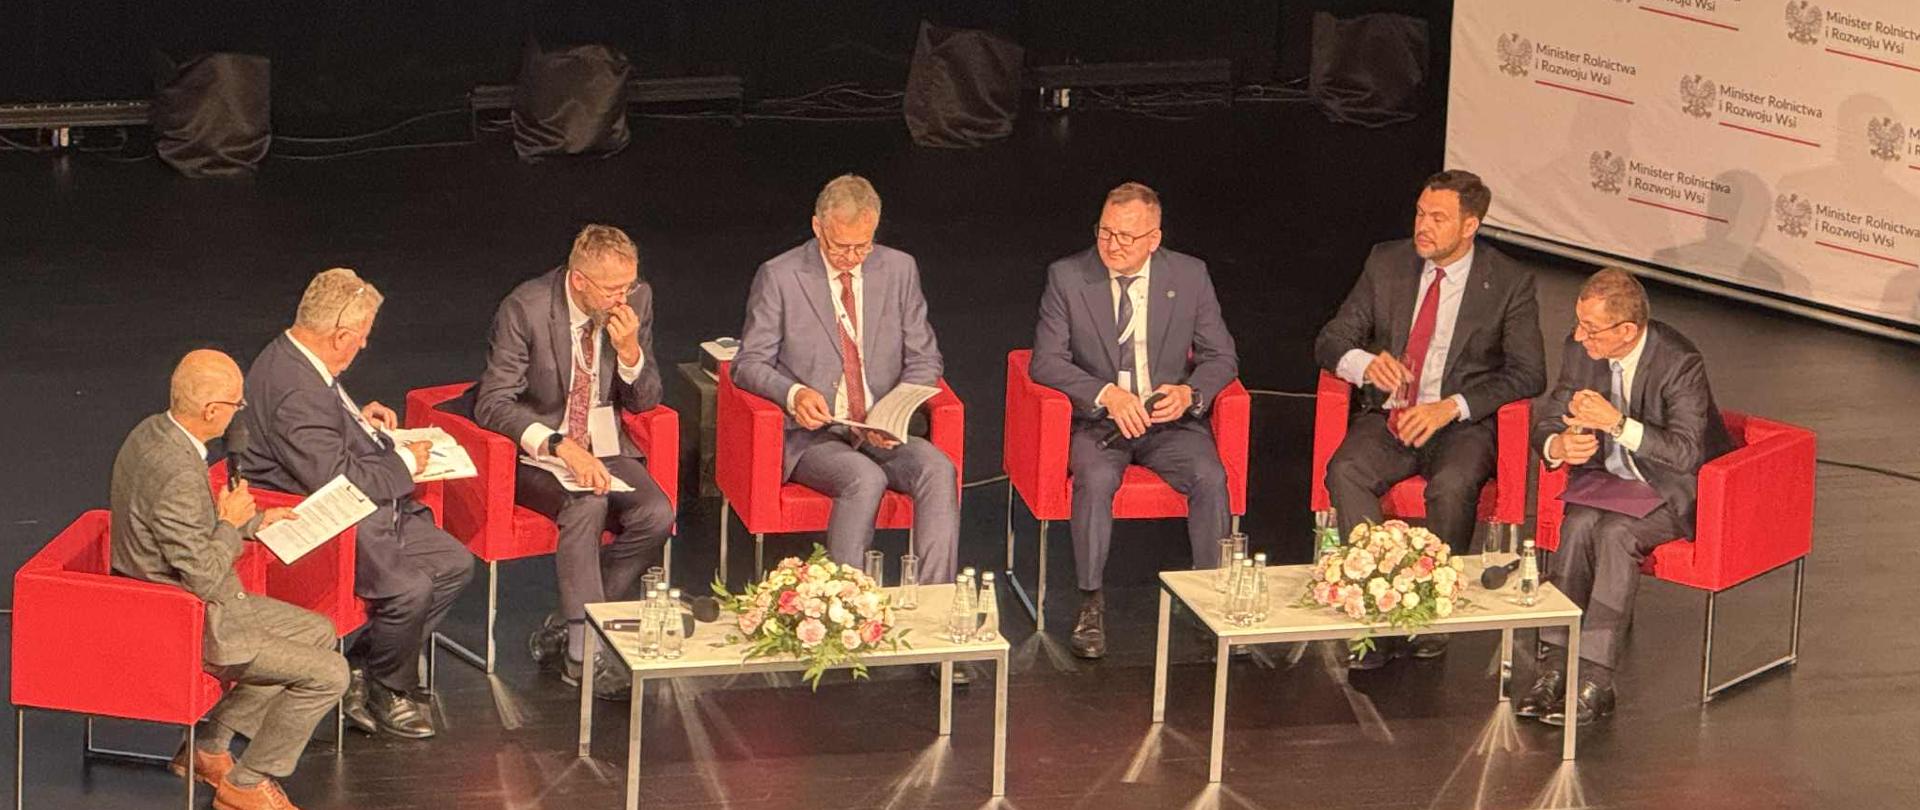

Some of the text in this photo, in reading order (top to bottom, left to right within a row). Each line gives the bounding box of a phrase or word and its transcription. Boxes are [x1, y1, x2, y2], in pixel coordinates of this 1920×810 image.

[1825, 10, 1872, 30] Minister
[1824, 26, 1904, 55] i Rozwoju Wsi
[1535, 58, 1612, 85] i Rozwoju Wsi
[1536, 42, 1636, 75] Minister Rolnictwa
[1719, 99, 1797, 128] i Rozwoju Wsi
[1720, 84, 1822, 118] Minister Rolnictwa
[1628, 176, 1705, 204] i Rozwoju Wsi
[1629, 160, 1731, 194] Minister Rolnictwa
[1815, 219, 1894, 248] i Rozwoju Wsi
[1816, 204, 1920, 238] Minister Rolnictwa
